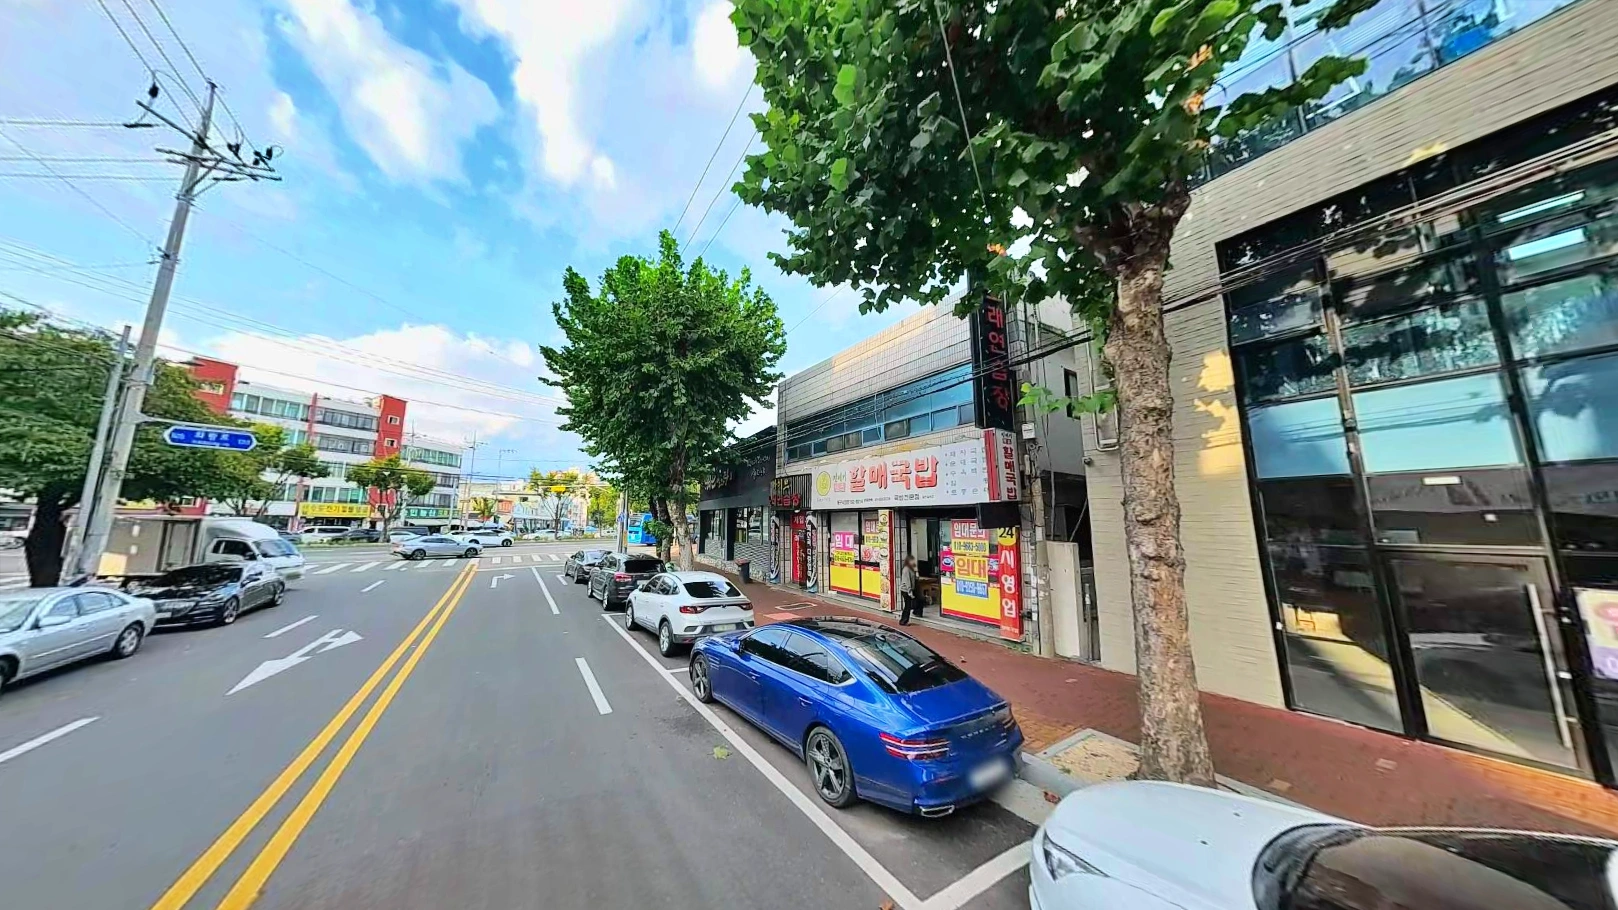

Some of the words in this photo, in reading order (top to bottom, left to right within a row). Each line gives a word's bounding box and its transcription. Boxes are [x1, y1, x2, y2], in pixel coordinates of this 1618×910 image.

[987, 295, 1011, 411] 래연습장
[850, 455, 939, 492] 할매국밥
[957, 558, 986, 579] 임대
